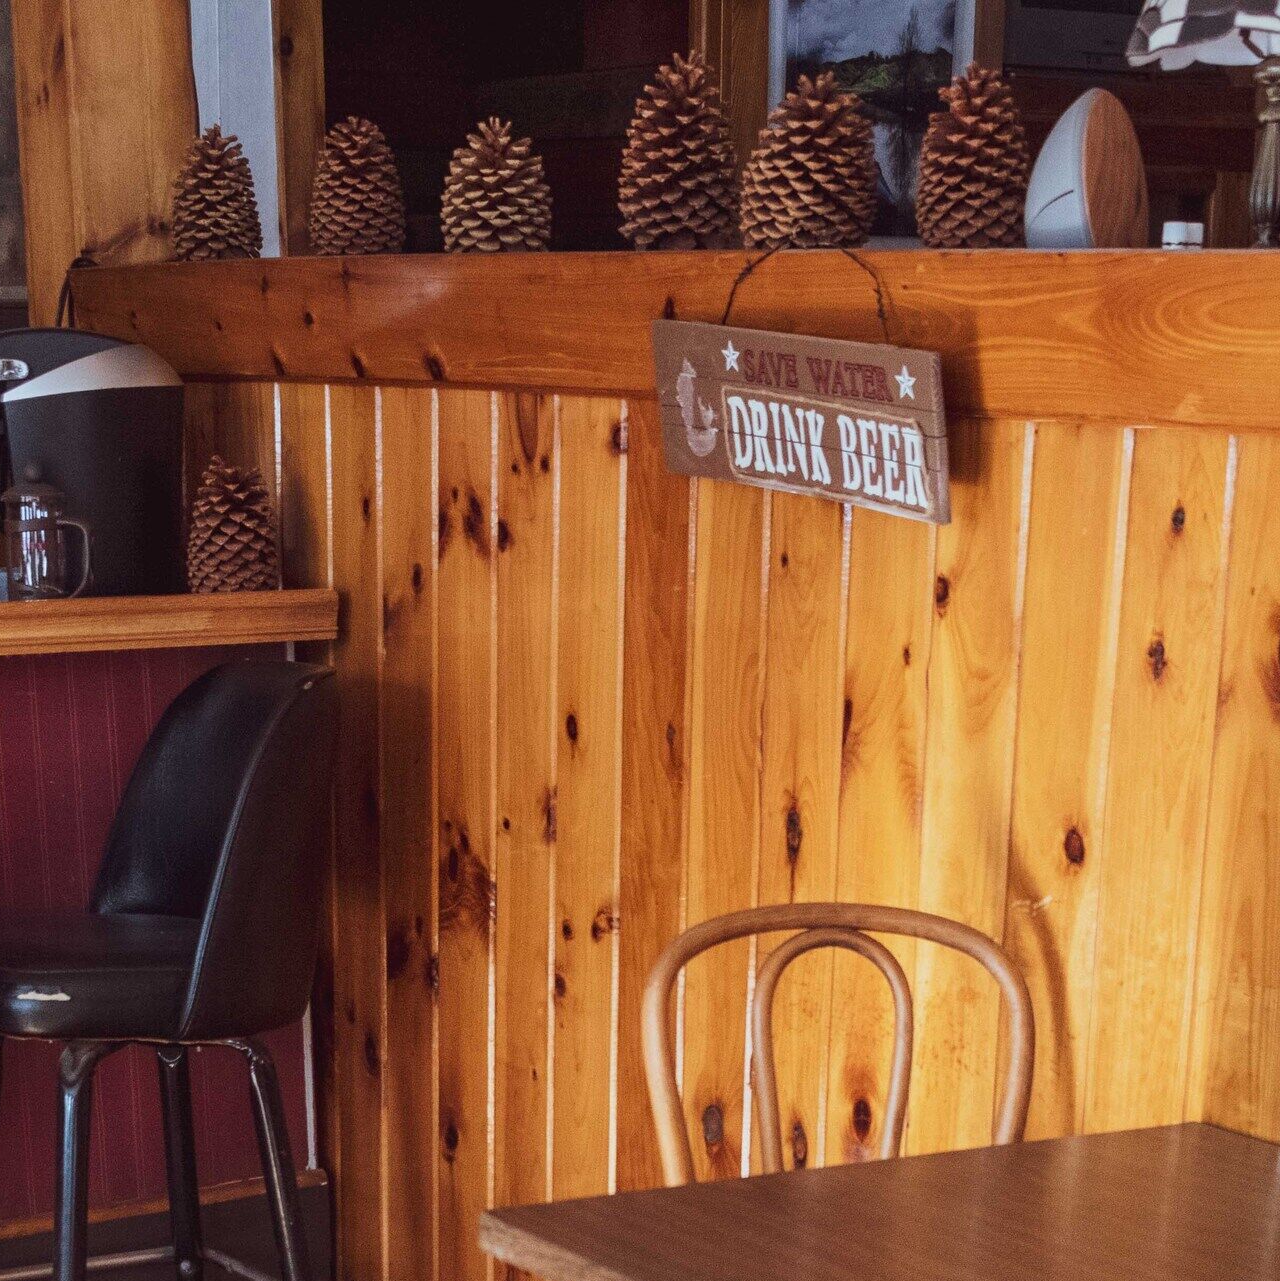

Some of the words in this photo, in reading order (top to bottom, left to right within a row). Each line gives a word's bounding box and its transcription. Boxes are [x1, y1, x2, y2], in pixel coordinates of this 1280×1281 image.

[742, 350, 798, 389] SAVE
[807, 357, 893, 401] WATER
[727, 396, 831, 485] DRINK
[836, 414, 928, 509] BEER
